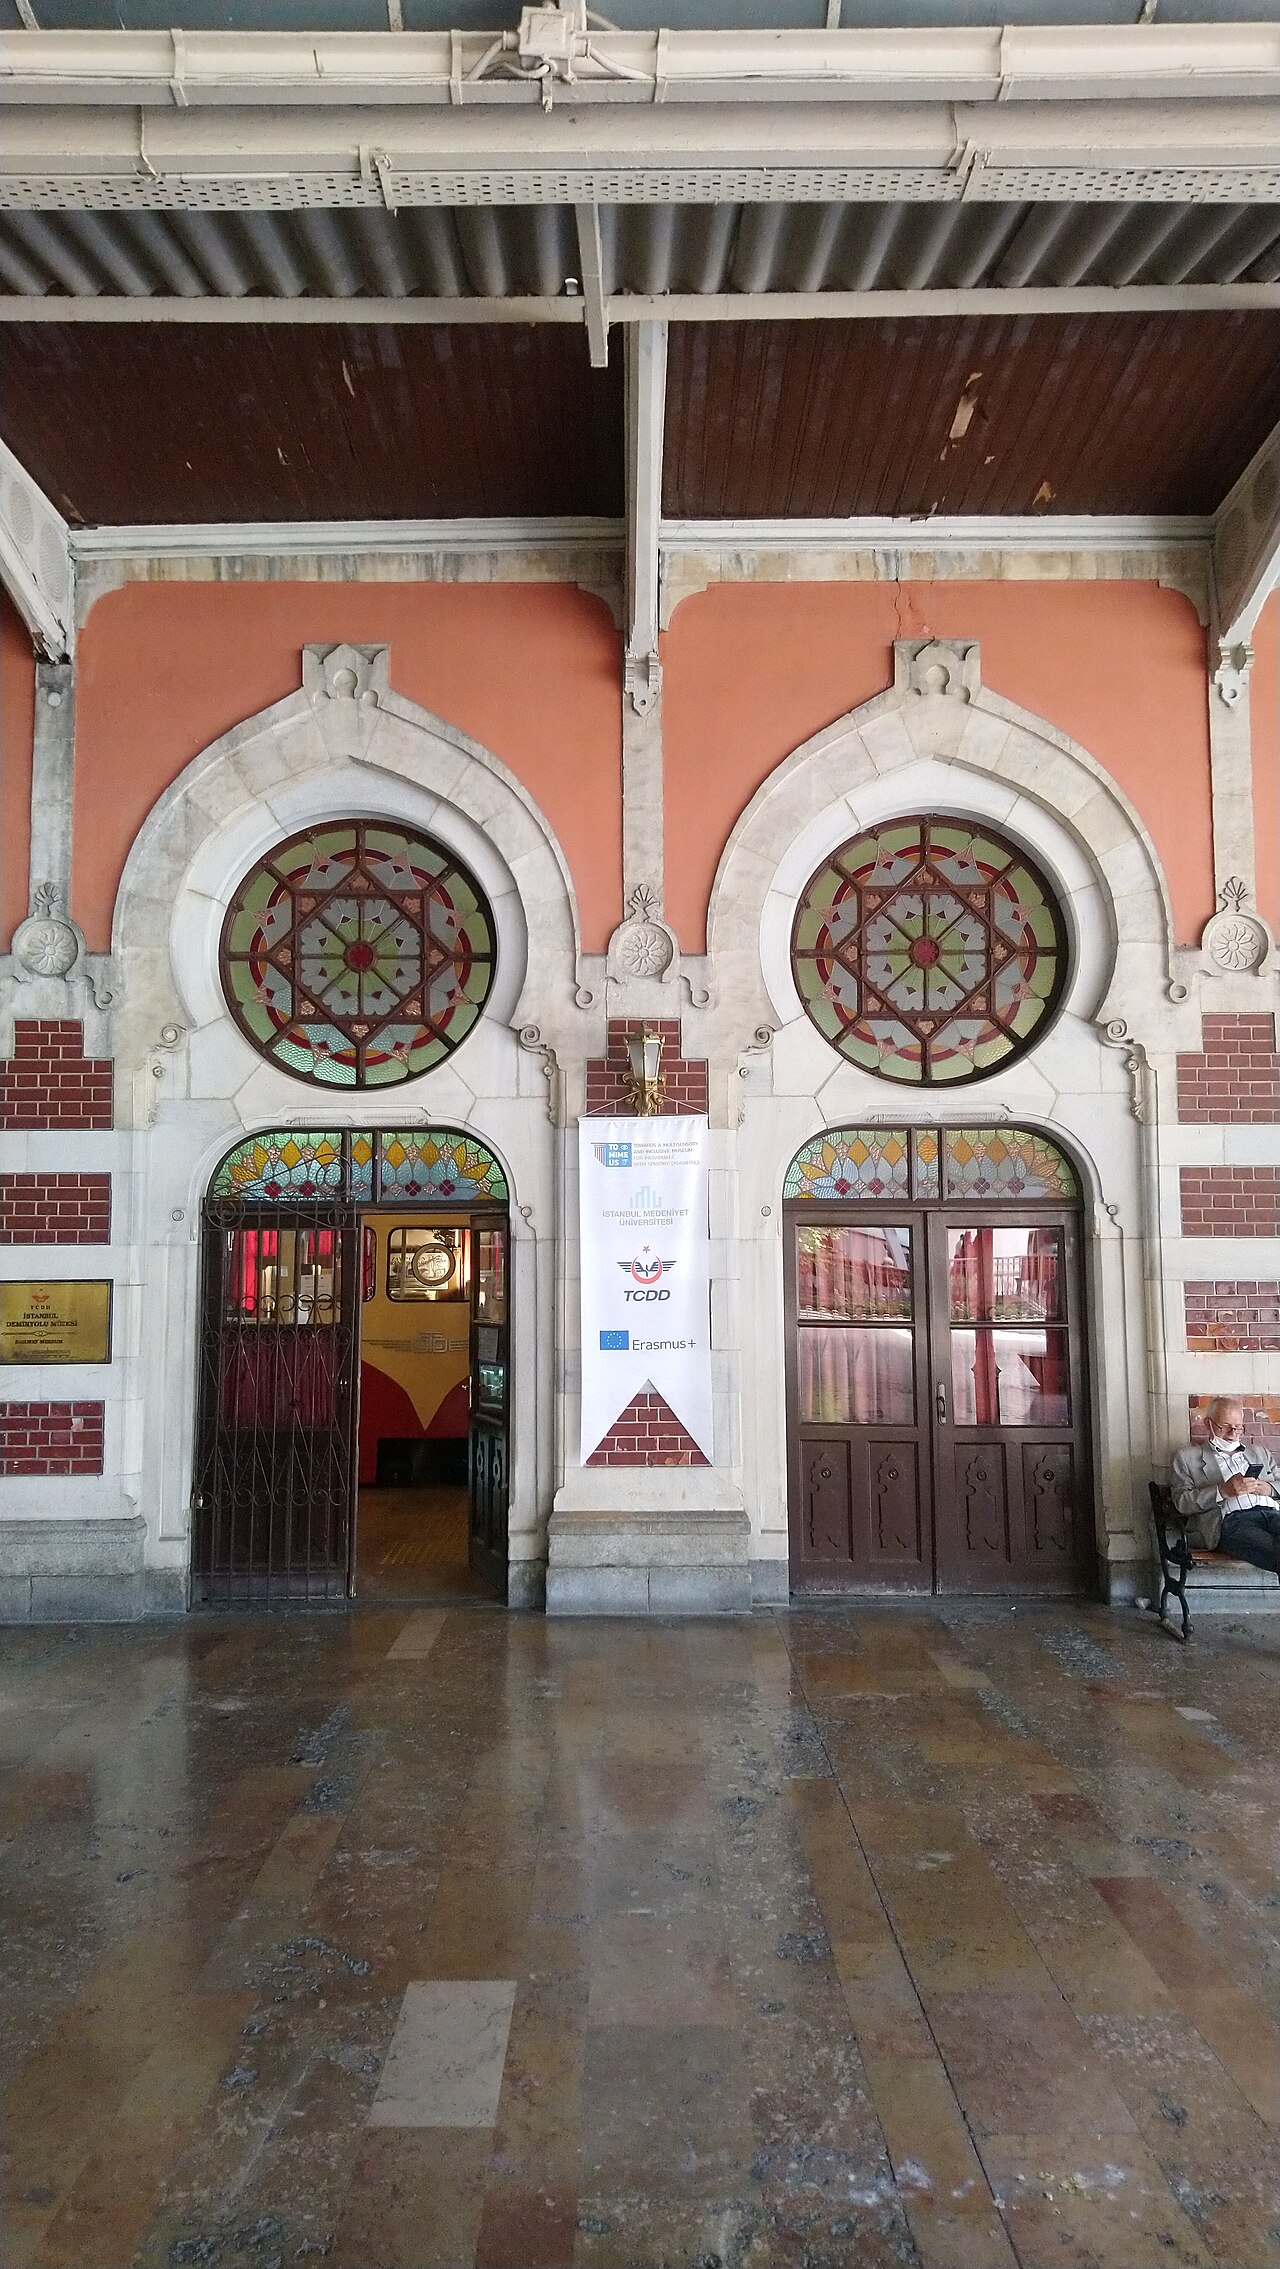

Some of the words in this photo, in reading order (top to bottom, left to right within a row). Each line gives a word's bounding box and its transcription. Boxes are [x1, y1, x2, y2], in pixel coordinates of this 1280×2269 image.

[609, 1143, 619, 1151] TO
[602, 1210, 642, 1218] İSTANBUL
[643, 1208, 690, 1217] MEDENİYET
[619, 1217, 674, 1227] ÜNİVERSİTESİ
[623, 1289, 671, 1302] TCDD
[632, 1338, 696, 1351] Erasmus+
